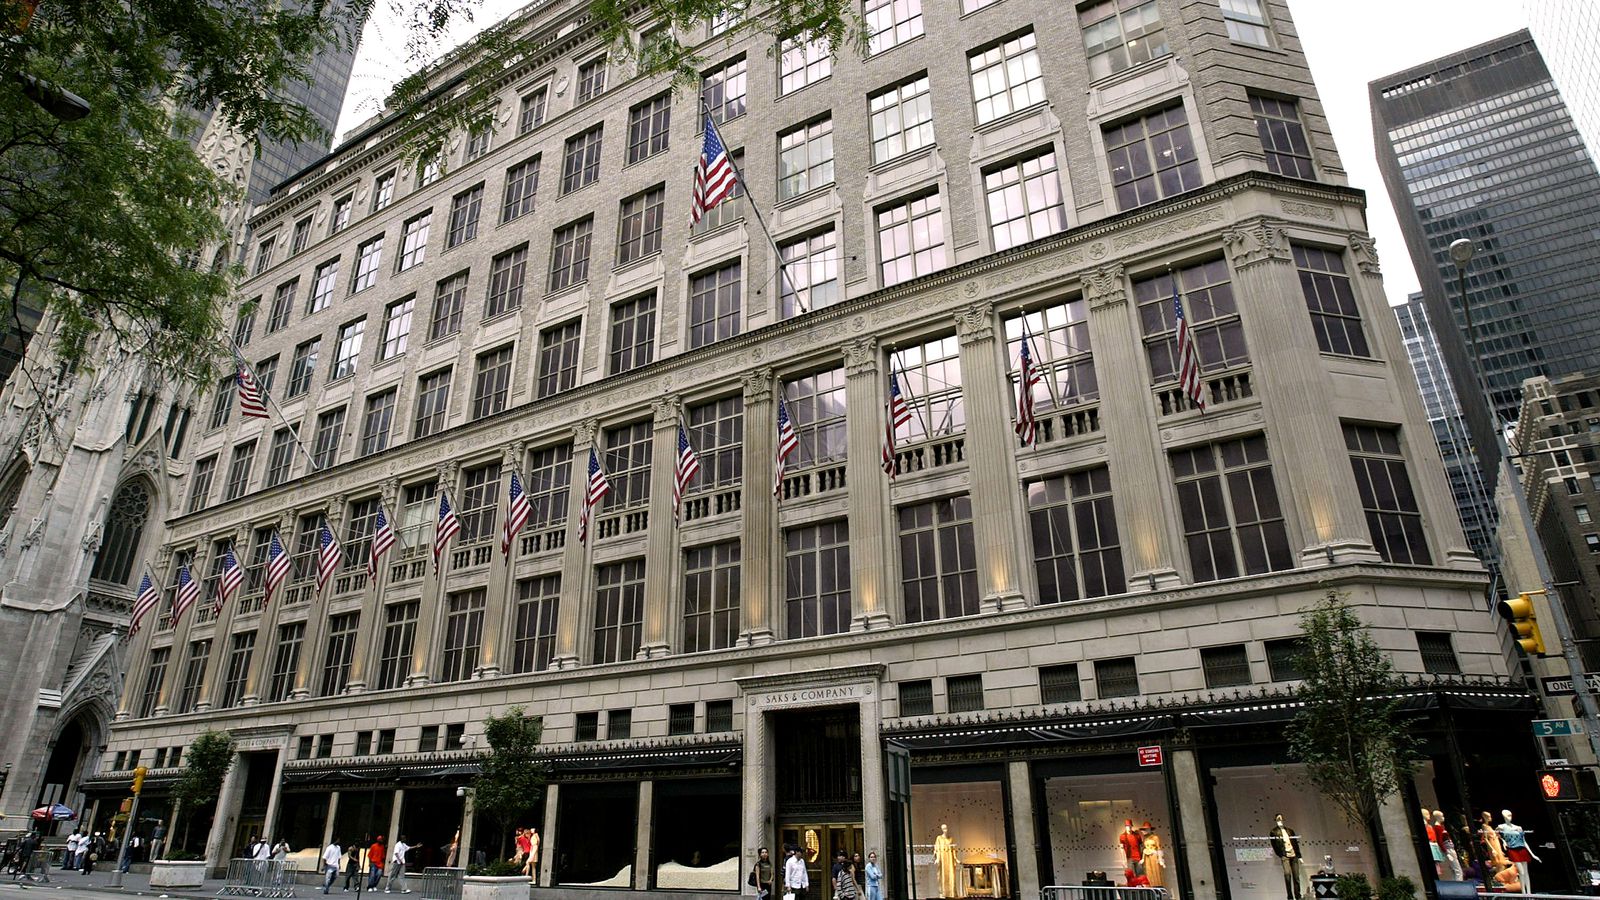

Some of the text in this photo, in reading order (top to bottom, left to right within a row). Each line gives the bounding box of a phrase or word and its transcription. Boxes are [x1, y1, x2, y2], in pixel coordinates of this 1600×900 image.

[1552, 681, 1574, 691] ONE
[766, 687, 854, 704] SAKS & COMPANY
[1542, 721, 1564, 735] 5 AV
